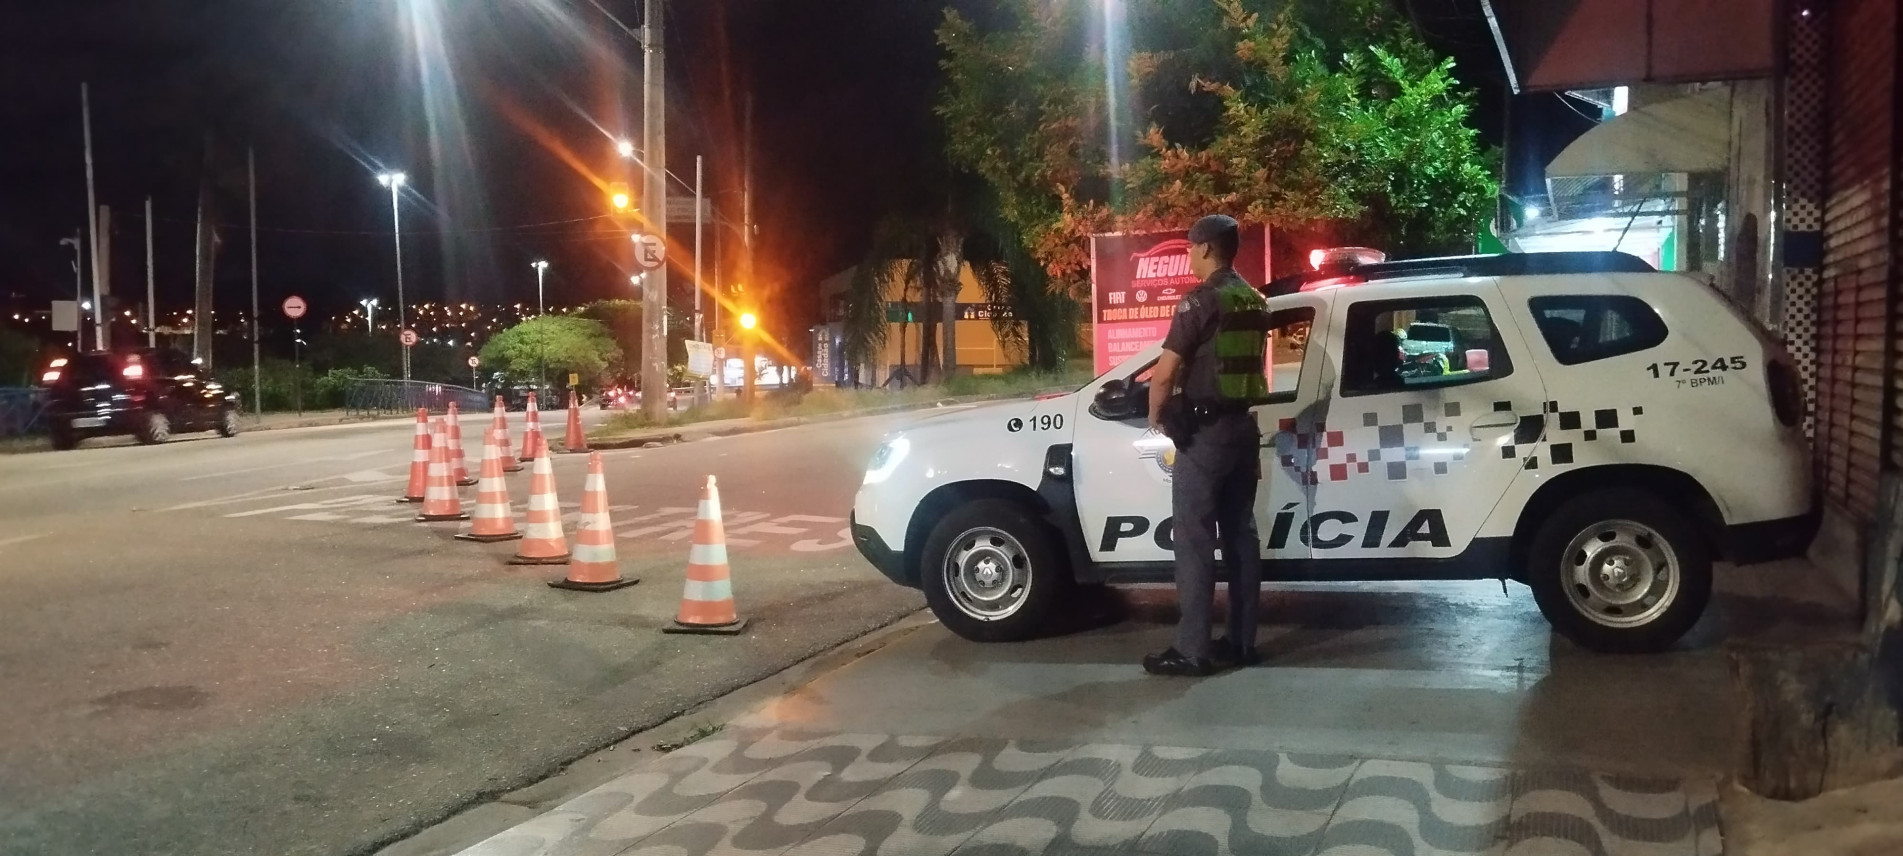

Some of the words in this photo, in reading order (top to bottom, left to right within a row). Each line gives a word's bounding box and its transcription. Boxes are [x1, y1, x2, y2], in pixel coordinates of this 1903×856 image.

[1131, 278, 1168, 288] SERVIÇOS
[1108, 291, 1126, 304] FIAT
[1102, 308, 1127, 321] TROCA
[1128, 308, 1139, 319] DE
[1140, 305, 1159, 319] ÓLEO
[1160, 305, 1170, 317] DE
[1107, 327, 1157, 339] ALINHAMENTO
[1646, 356, 1747, 378] 17-245
[1029, 413, 1064, 431] 190
[1099, 502, 1452, 552] PÍCIA
